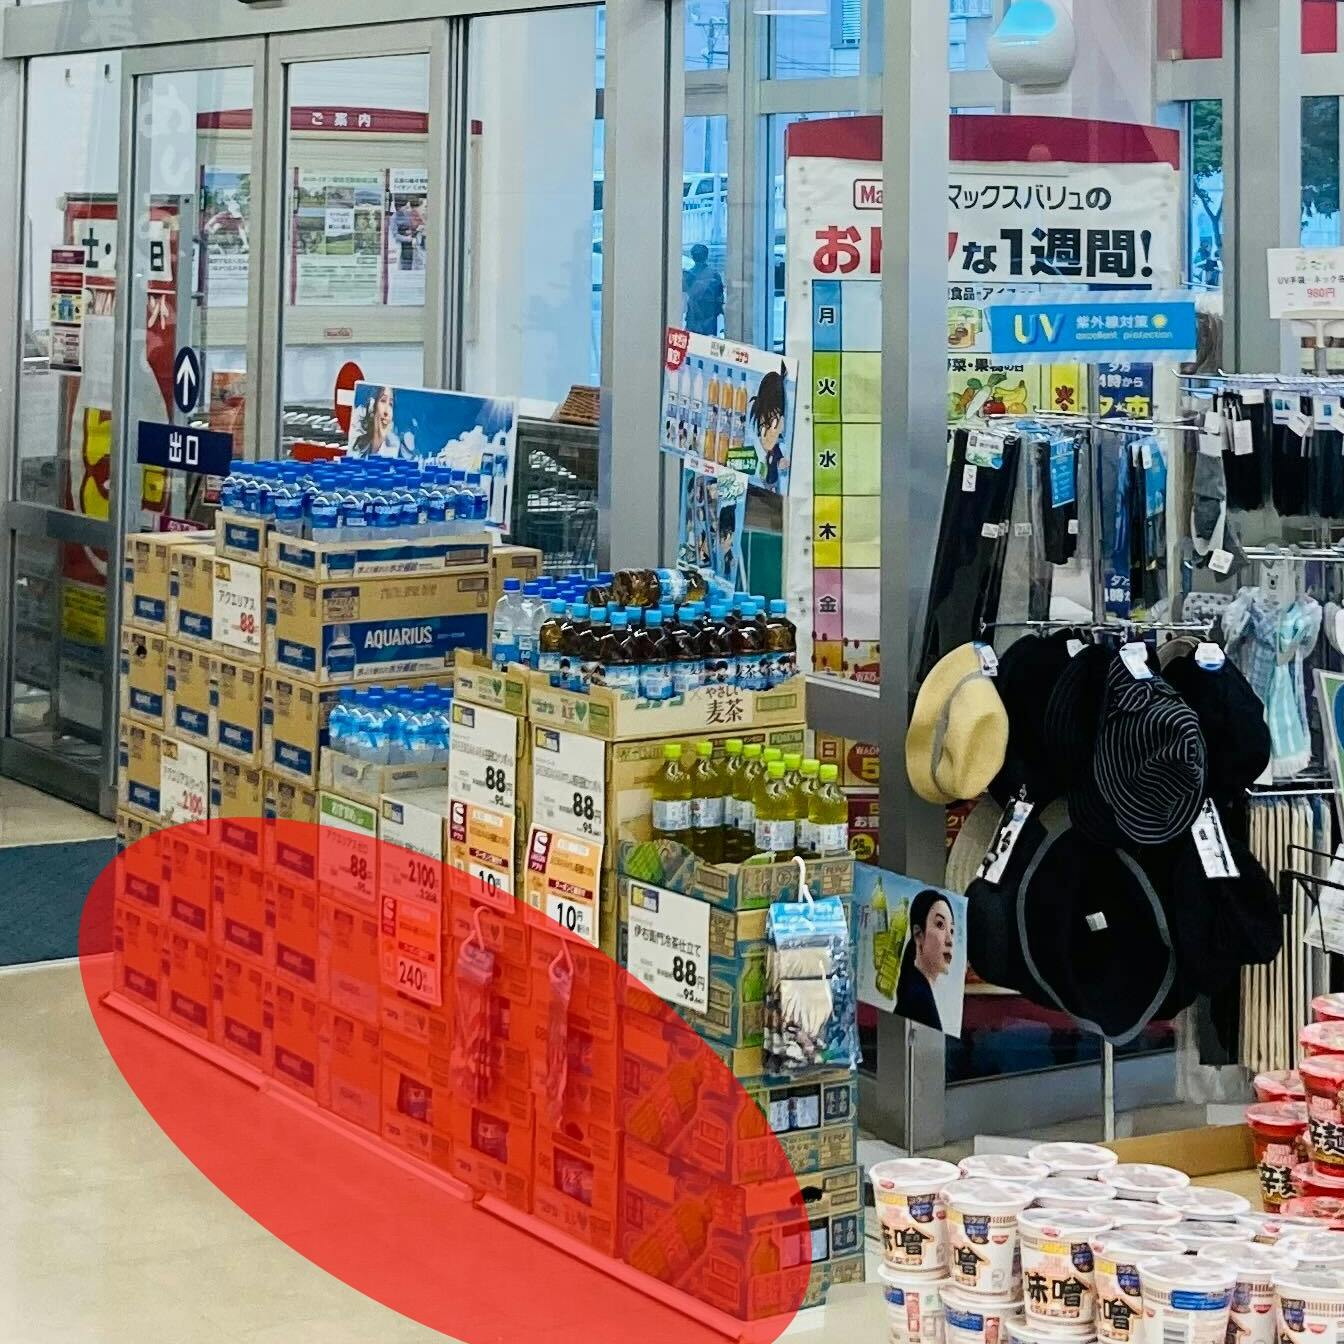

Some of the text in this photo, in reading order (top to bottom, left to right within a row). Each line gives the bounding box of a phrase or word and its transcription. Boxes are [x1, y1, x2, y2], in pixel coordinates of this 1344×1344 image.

[818, 307, 837, 324] 月
[1014, 313, 1063, 345] UV
[818, 379, 837, 397] 火
[168, 431, 199, 466] 出口
[818, 451, 837, 469] 水
[818, 523, 837, 541] 木
[818, 596, 837, 614] 金
[364, 625, 433, 649] AQUARIUS
[705, 698, 744, 725] 麦茶
